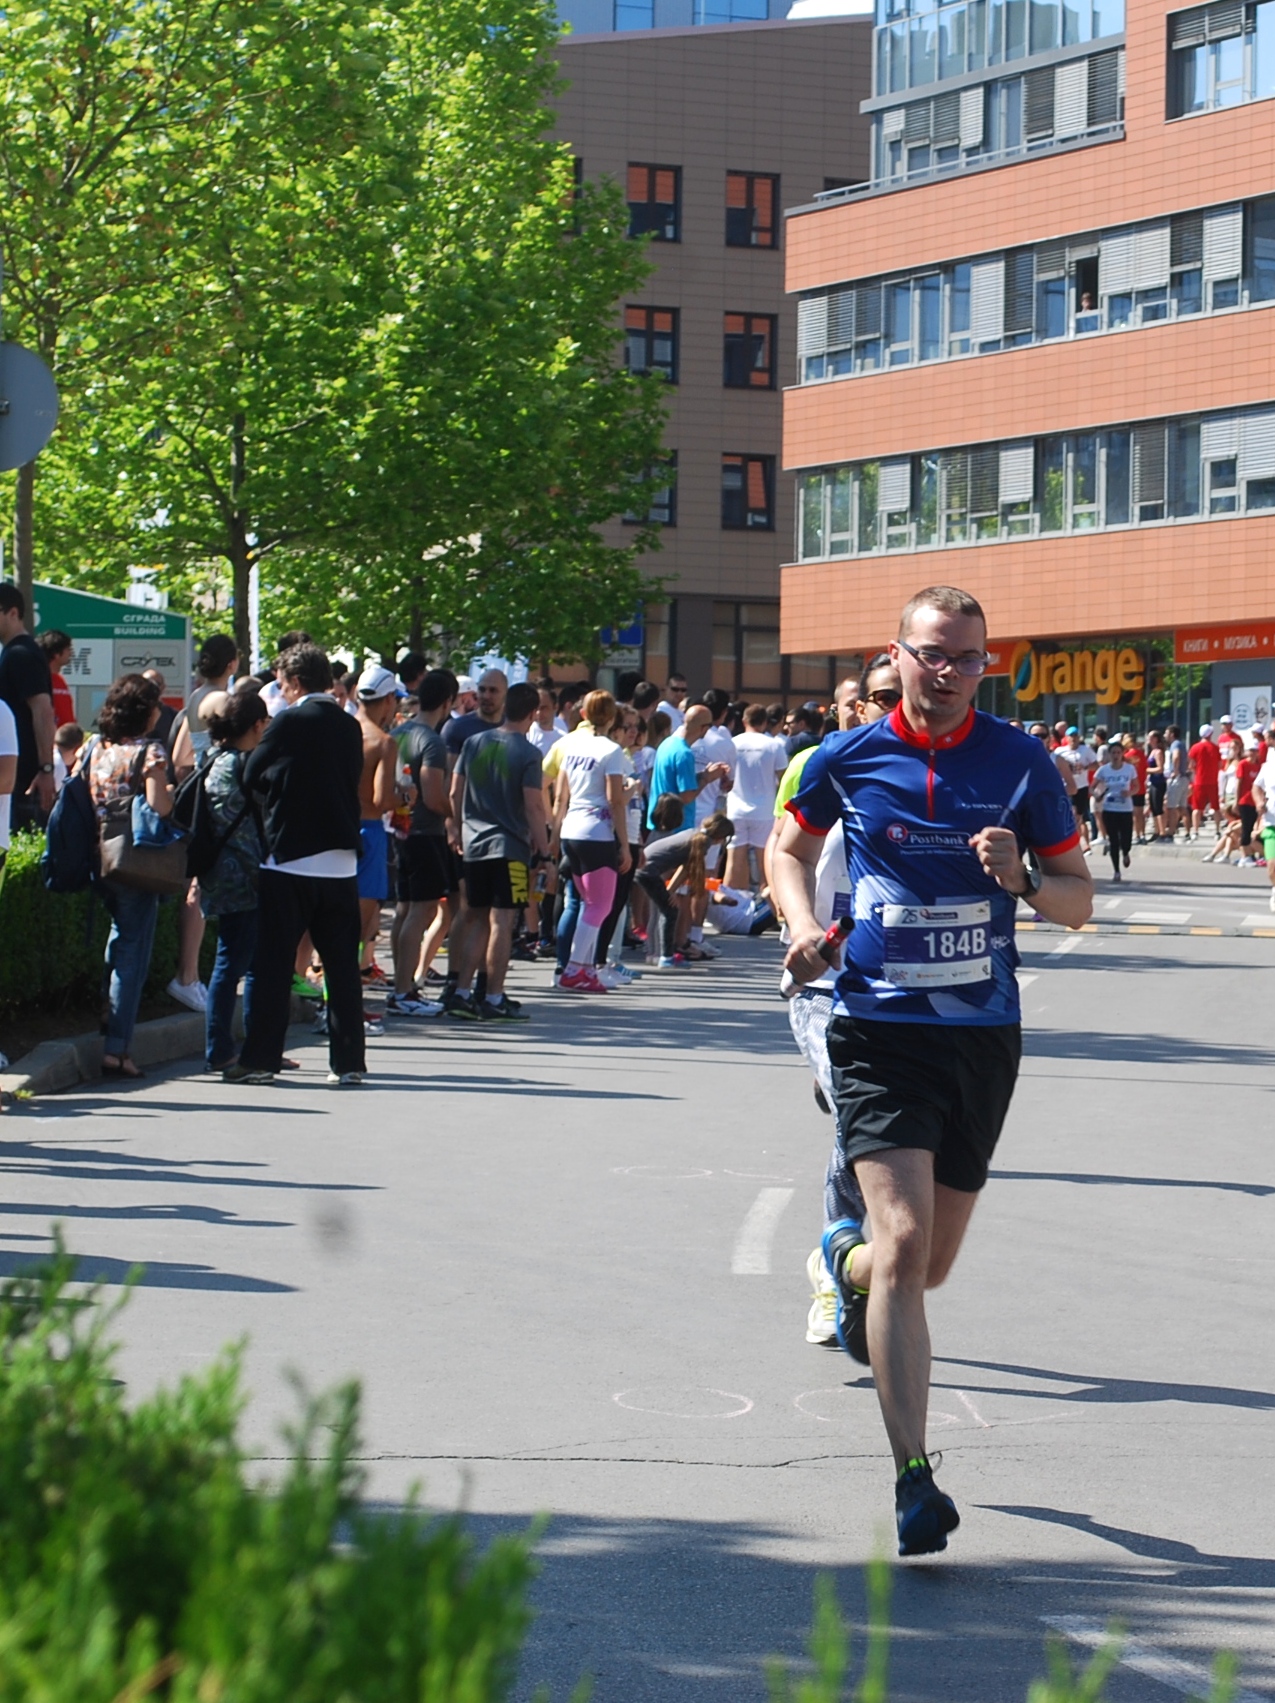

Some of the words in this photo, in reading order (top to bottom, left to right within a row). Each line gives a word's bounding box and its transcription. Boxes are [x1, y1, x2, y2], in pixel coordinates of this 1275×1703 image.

[122, 614, 166, 623] СГРАДА
[113, 626, 166, 636] BUILDING
[1223, 634, 1258, 651] МУЗИКА
[1009, 640, 1145, 705] Orange
[909, 833, 965, 847] Postbank
[923, 928, 986, 958] 184B
